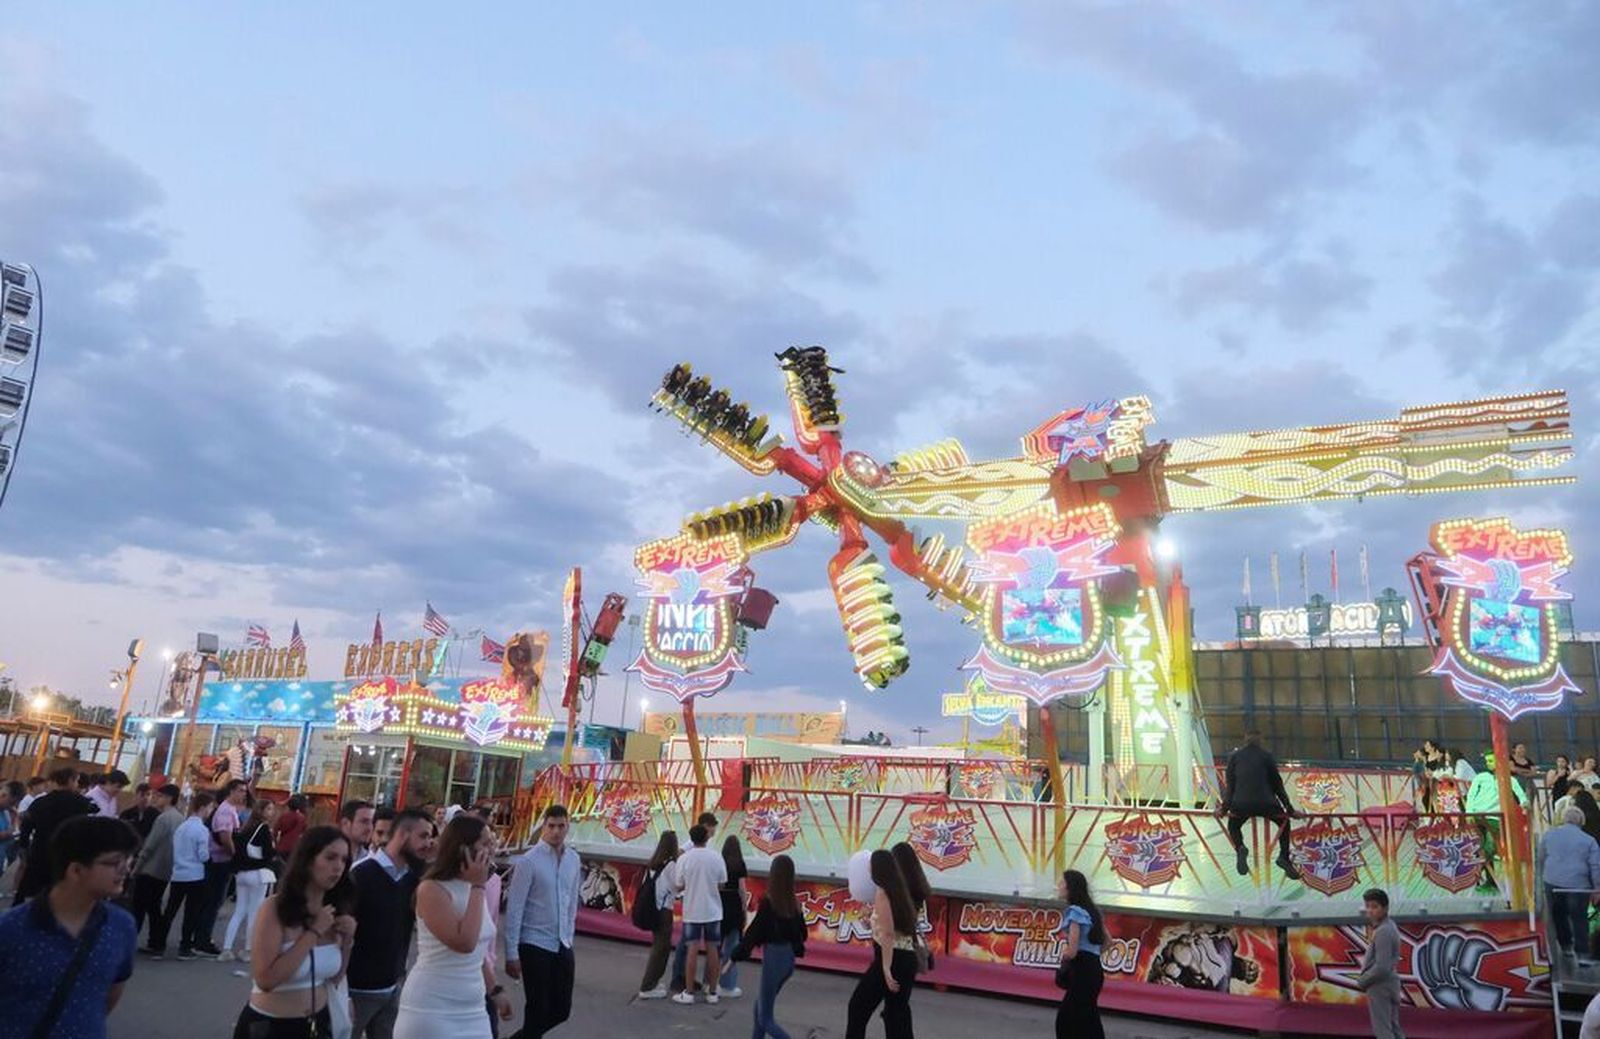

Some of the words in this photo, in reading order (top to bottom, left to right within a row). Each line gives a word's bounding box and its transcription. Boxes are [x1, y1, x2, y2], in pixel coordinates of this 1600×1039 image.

[972, 511, 1110, 548] EXTREME
[641, 541, 738, 568] EXTREME
[1448, 527, 1565, 560] EXTREME
[344, 638, 438, 677] EXPRESS
[1119, 601, 1169, 755] XTREME
[464, 683, 519, 701] EXTREME
[1107, 817, 1183, 841] EXTREME
[1290, 823, 1361, 847] EXTREME
[961, 904, 1063, 932] NOVEDAD
[1024, 928, 1051, 941] DEL
